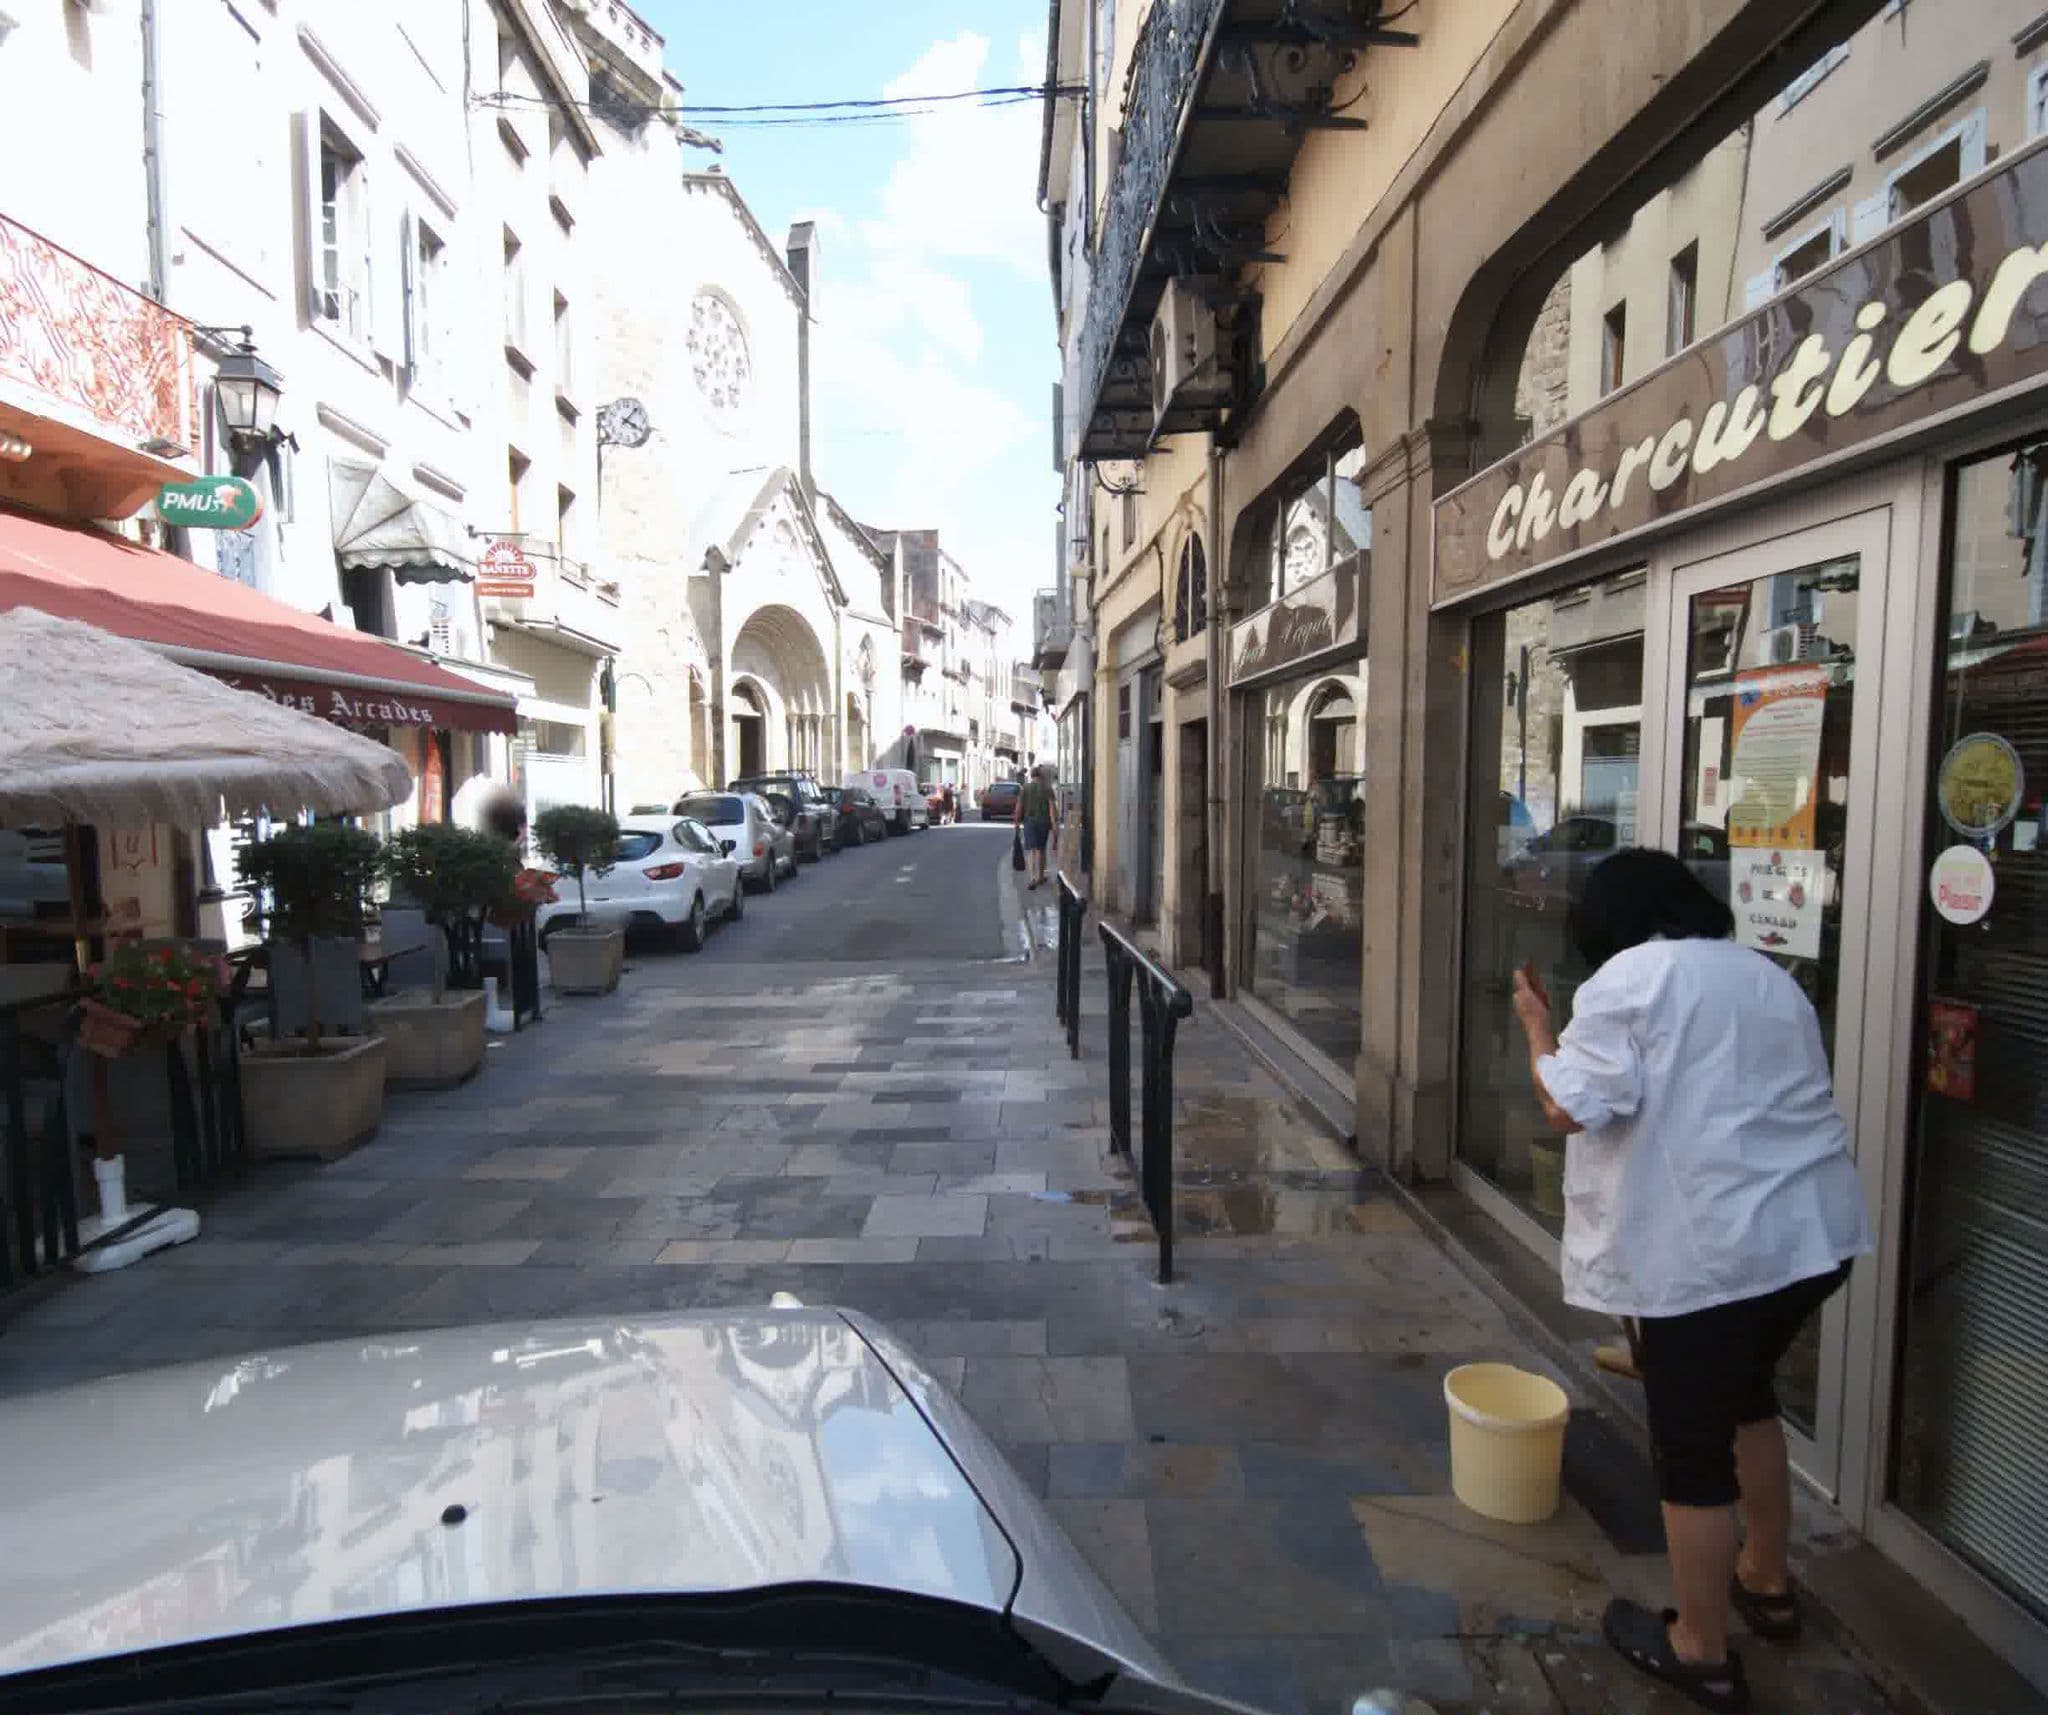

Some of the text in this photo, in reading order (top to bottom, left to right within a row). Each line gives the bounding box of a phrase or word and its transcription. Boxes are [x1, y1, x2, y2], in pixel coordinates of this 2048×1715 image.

[1486, 241, 2048, 560] Charcutier
[162, 492, 212, 512] PMU
[330, 690, 432, 723] Arcades
